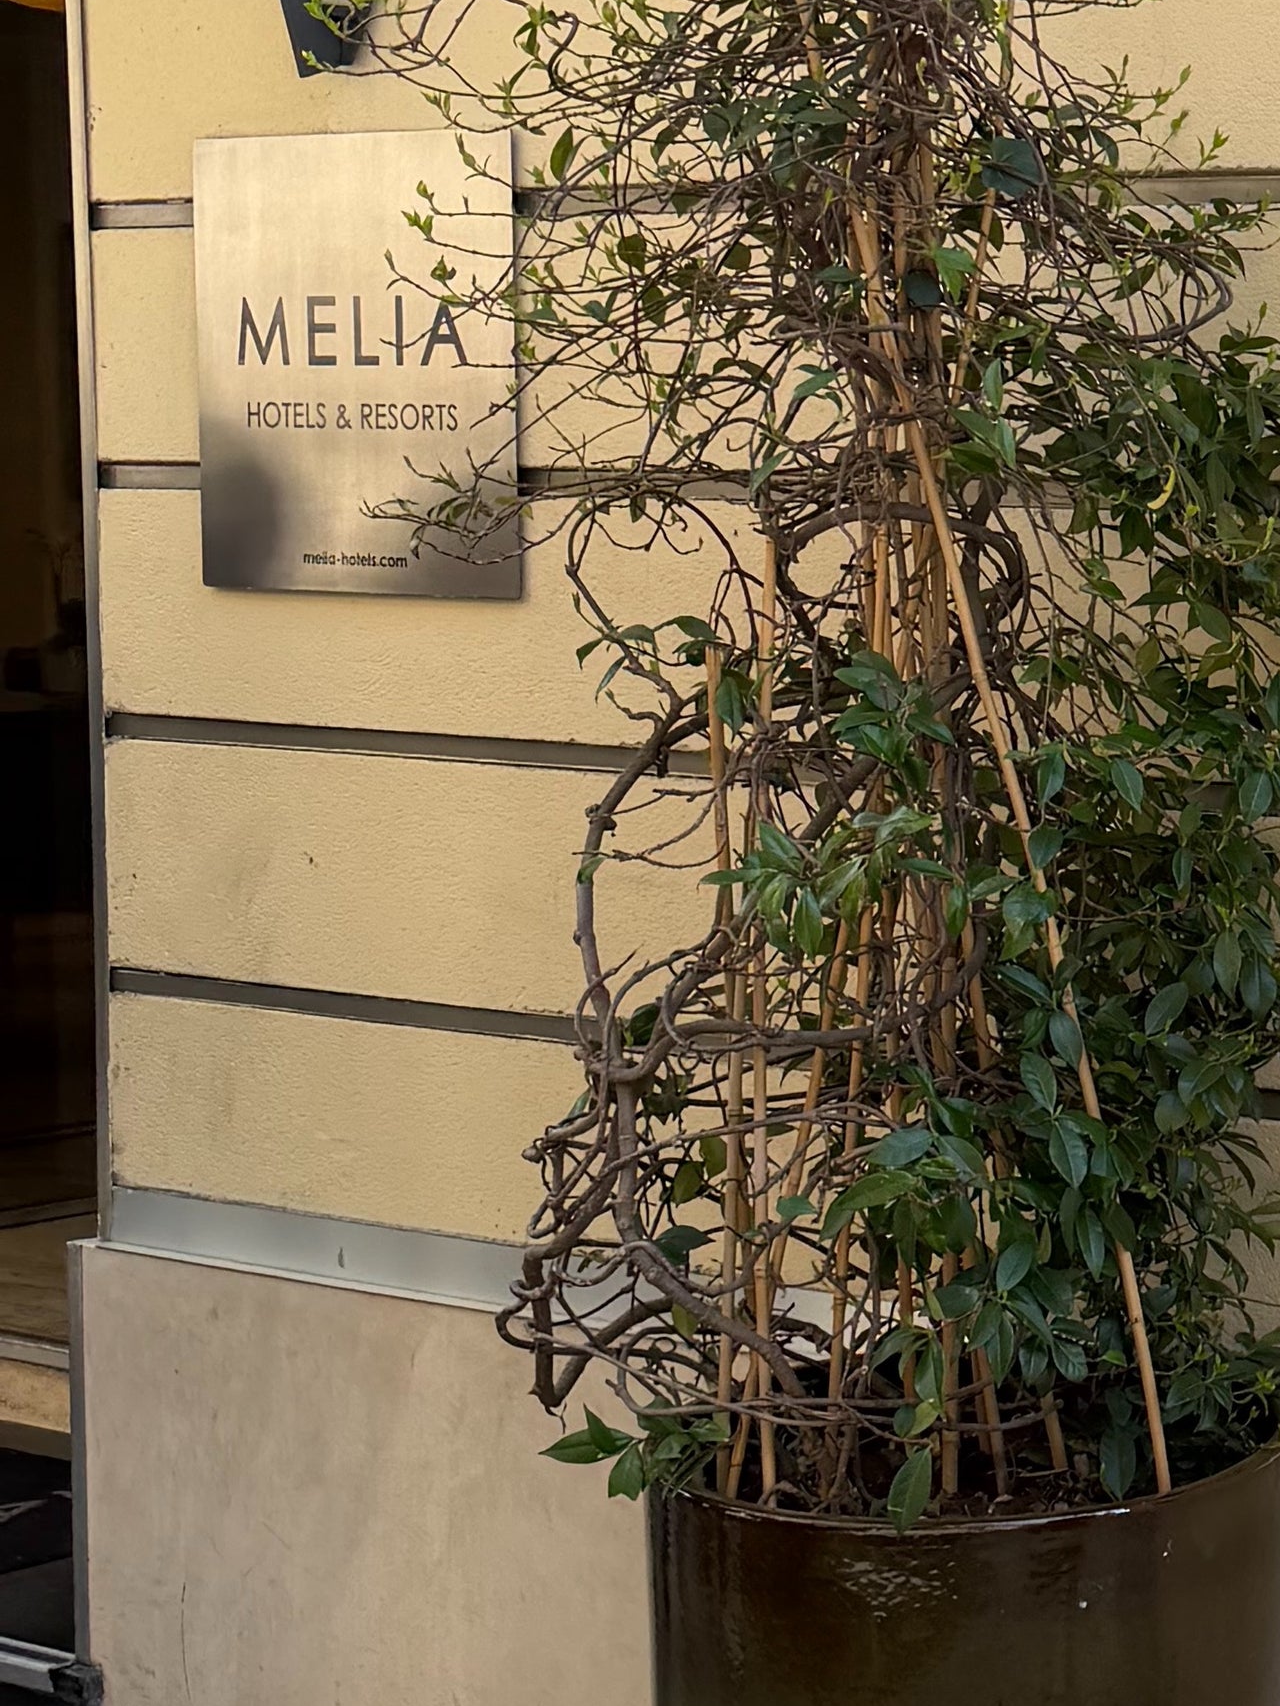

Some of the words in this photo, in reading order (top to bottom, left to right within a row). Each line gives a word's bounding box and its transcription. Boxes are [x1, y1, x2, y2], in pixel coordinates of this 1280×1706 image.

[237, 295, 467, 366] MELIA
[247, 401, 327, 430] HOTELS
[335, 403, 353, 430] &
[360, 403, 459, 432] RESORTS
[303, 551, 408, 568] melia-hotels.com
